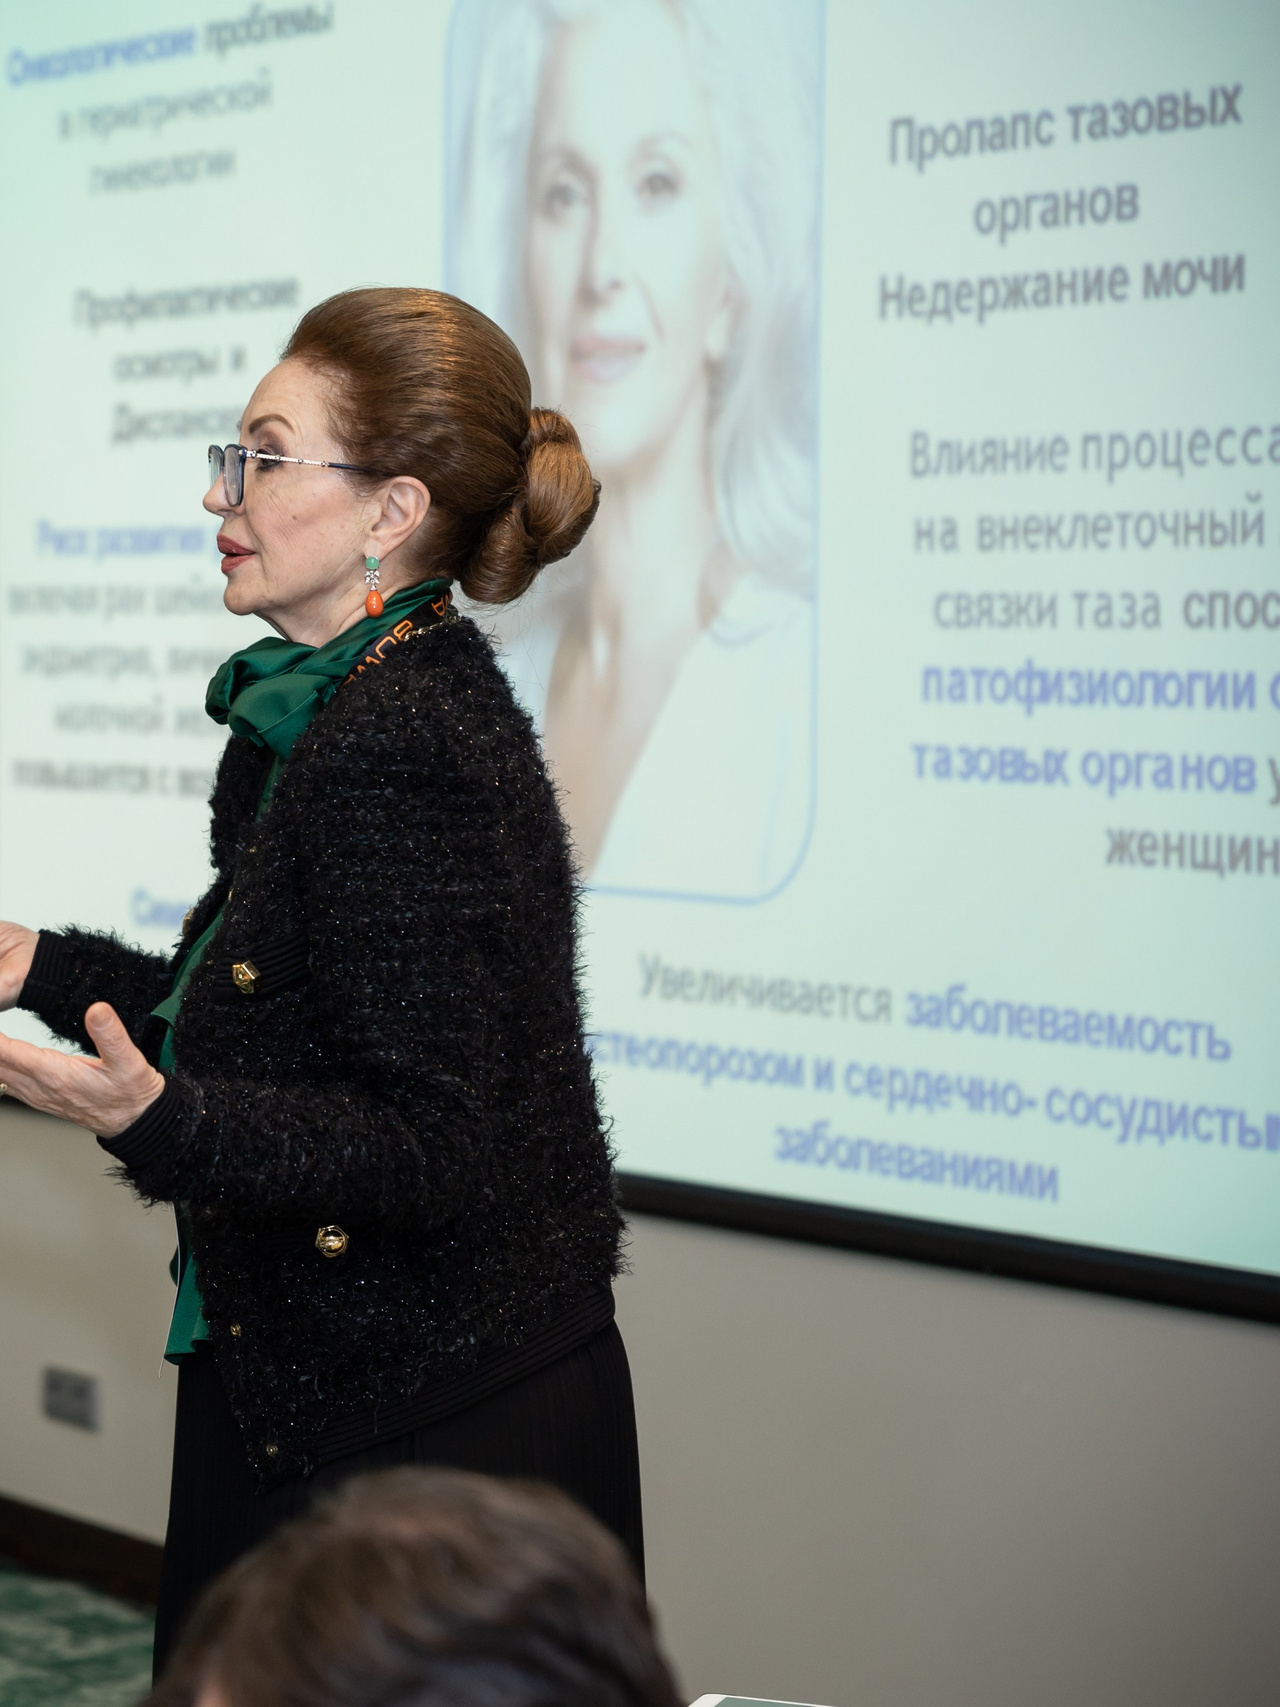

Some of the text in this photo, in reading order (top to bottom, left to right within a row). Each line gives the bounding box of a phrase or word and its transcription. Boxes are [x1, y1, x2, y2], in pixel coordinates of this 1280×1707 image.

[890, 83, 1244, 173] Пролапс тазовых
[974, 183, 1140, 246] органов
[879, 254, 1246, 325] Недержание мочи
[910, 430, 1070, 478] Влияние
[914, 491, 1266, 553] на внеклеточный
[933, 591, 1059, 630] связки
[1072, 590, 1162, 630] таза
[921, 656, 1256, 718] патофизиологии
[912, 744, 1070, 786] тазовых
[1081, 750, 1258, 798] органов
[1105, 828, 1280, 881] женщин
[637, 951, 1233, 1063] Увеличивается заболеваемость
[586, 1030, 1280, 1153] стеопорозом и сердечно- сосудисты
[776, 1121, 1060, 1203] заболеваниями
